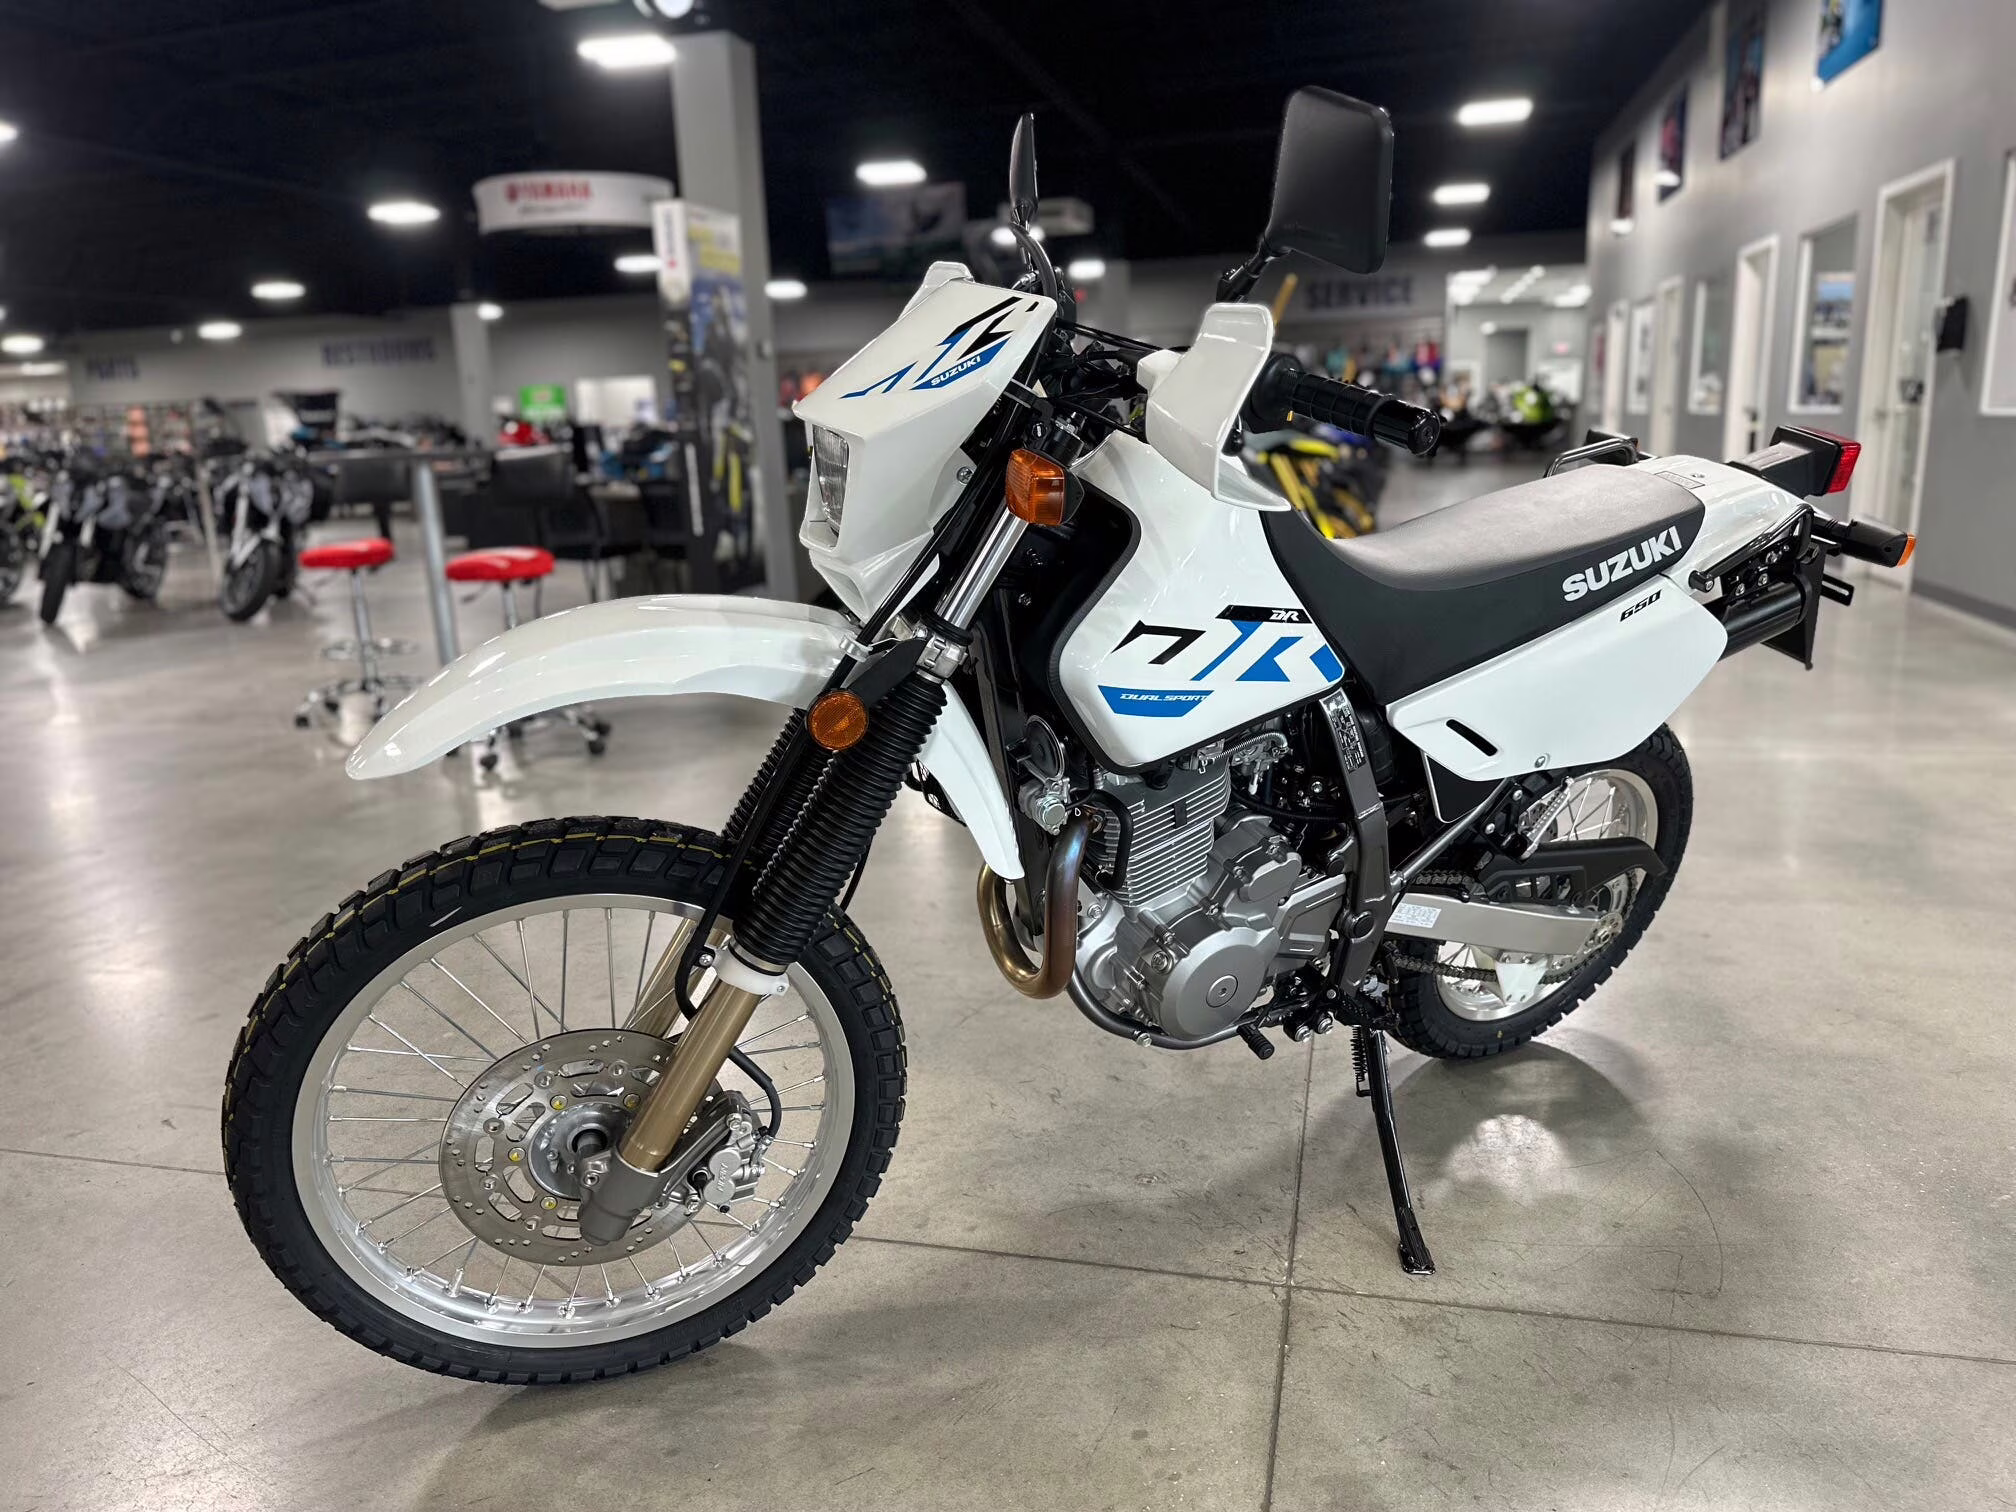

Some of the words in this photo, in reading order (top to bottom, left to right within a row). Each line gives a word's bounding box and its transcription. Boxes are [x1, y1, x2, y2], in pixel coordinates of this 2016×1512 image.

[1306, 276, 1412, 310] SERVICE
[930, 355, 982, 386] SUZUKI
[1562, 525, 1682, 602] SUZUKI
[1269, 609, 1300, 622] DR
[1619, 588, 1662, 622] 650
[1119, 693, 1162, 701] DUAL
[1163, 694, 1208, 702] SPORT
